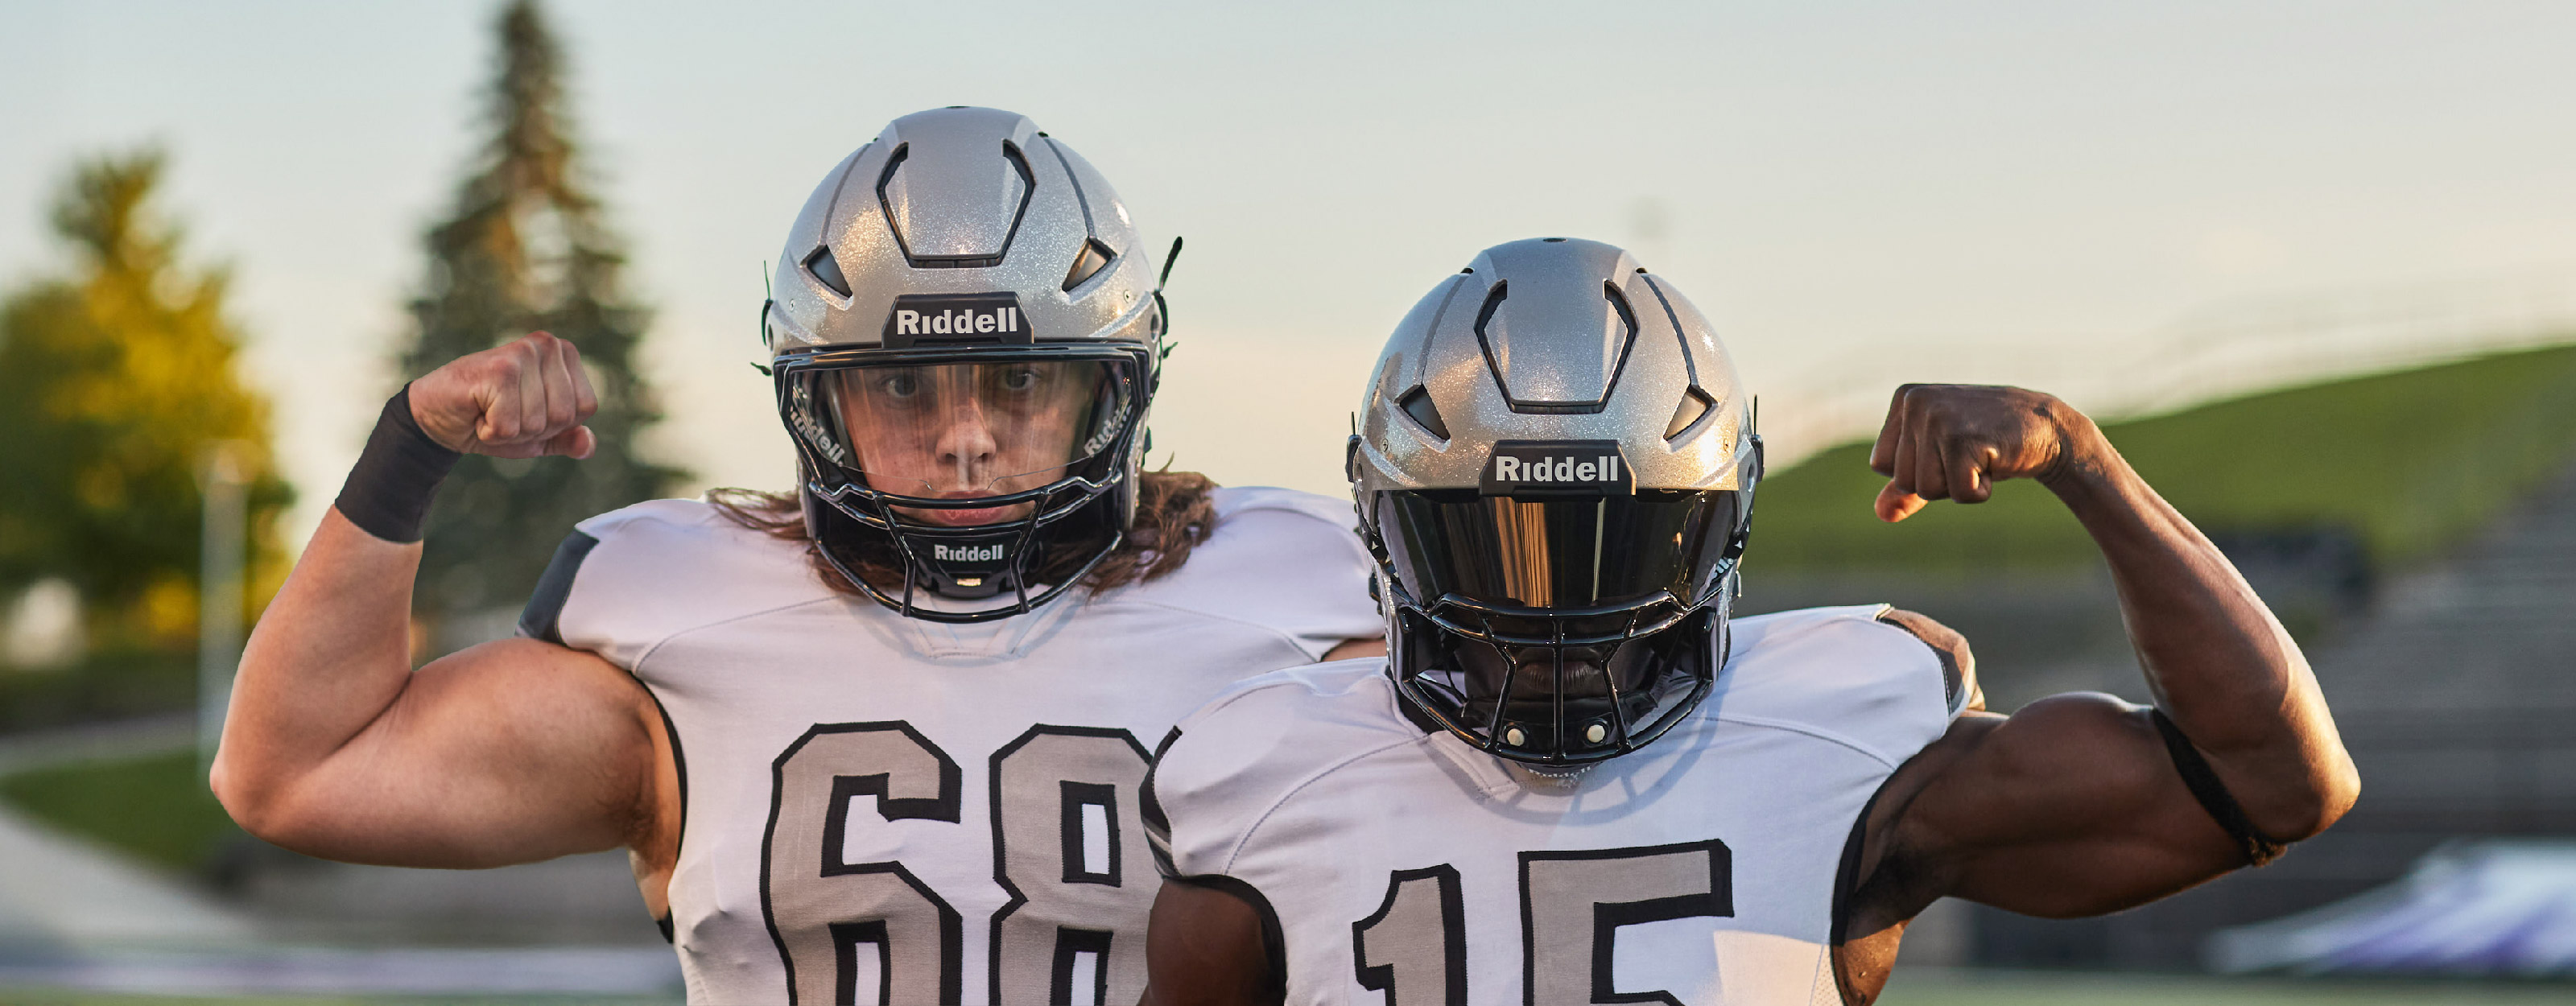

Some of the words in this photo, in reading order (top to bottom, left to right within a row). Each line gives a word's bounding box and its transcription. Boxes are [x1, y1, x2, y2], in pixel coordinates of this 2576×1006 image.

[897, 307, 1018, 335] Riddell
[1496, 456, 1619, 482] Riddell
[934, 544, 1003, 562] Riddell
[760, 719, 1162, 1006] 68
